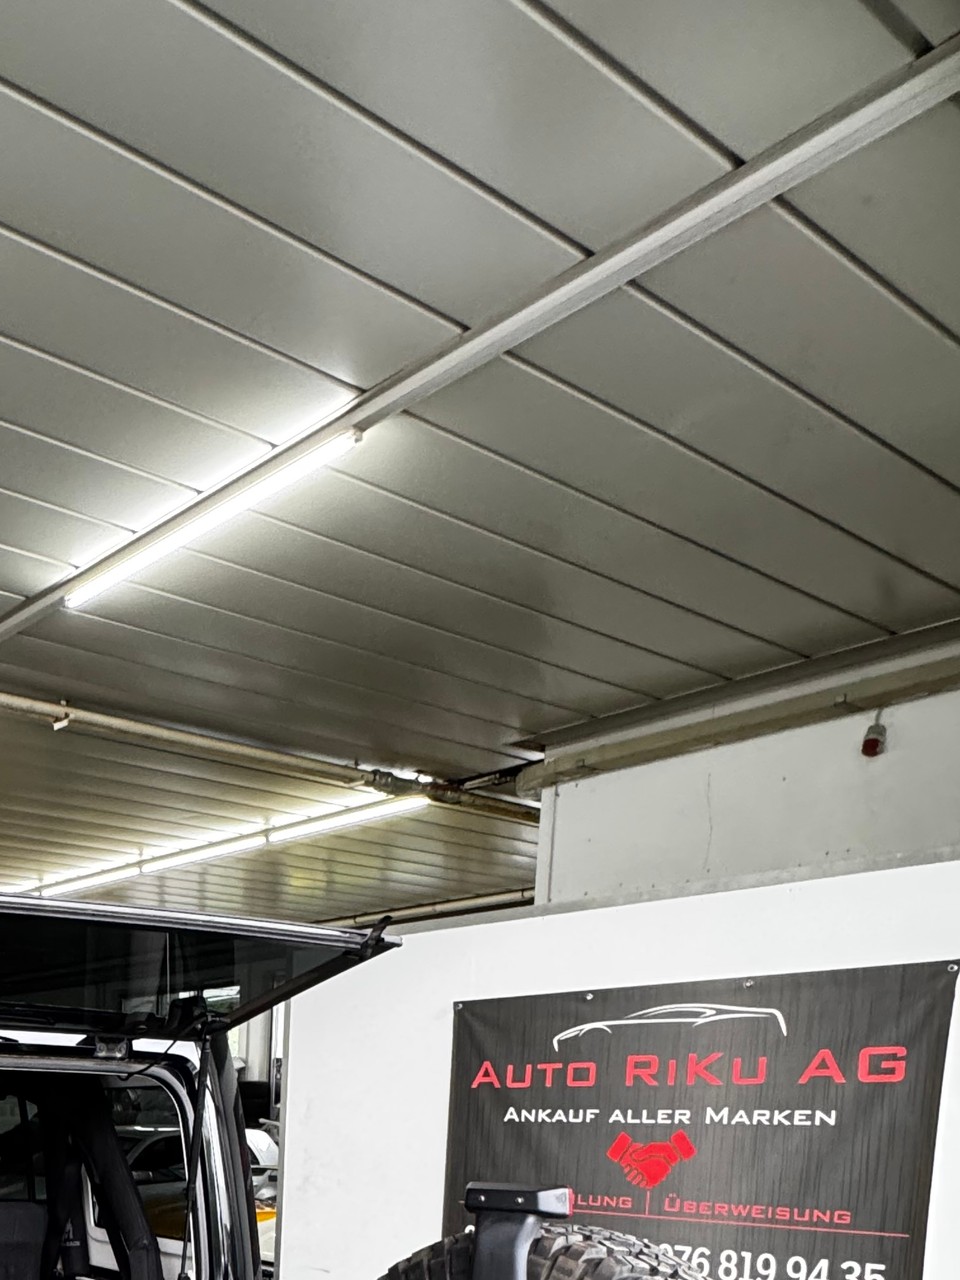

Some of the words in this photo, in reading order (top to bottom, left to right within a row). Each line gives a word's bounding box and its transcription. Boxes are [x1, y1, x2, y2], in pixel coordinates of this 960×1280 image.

[471, 1060, 597, 1089] AUTO
[797, 1045, 908, 1085] AG
[503, 1106, 601, 1124] ANKAUF
[608, 1108, 691, 1125] ALLER
[705, 1106, 837, 1127] MARKEN
[663, 1192, 852, 1225] ÜBERWEISUNG
